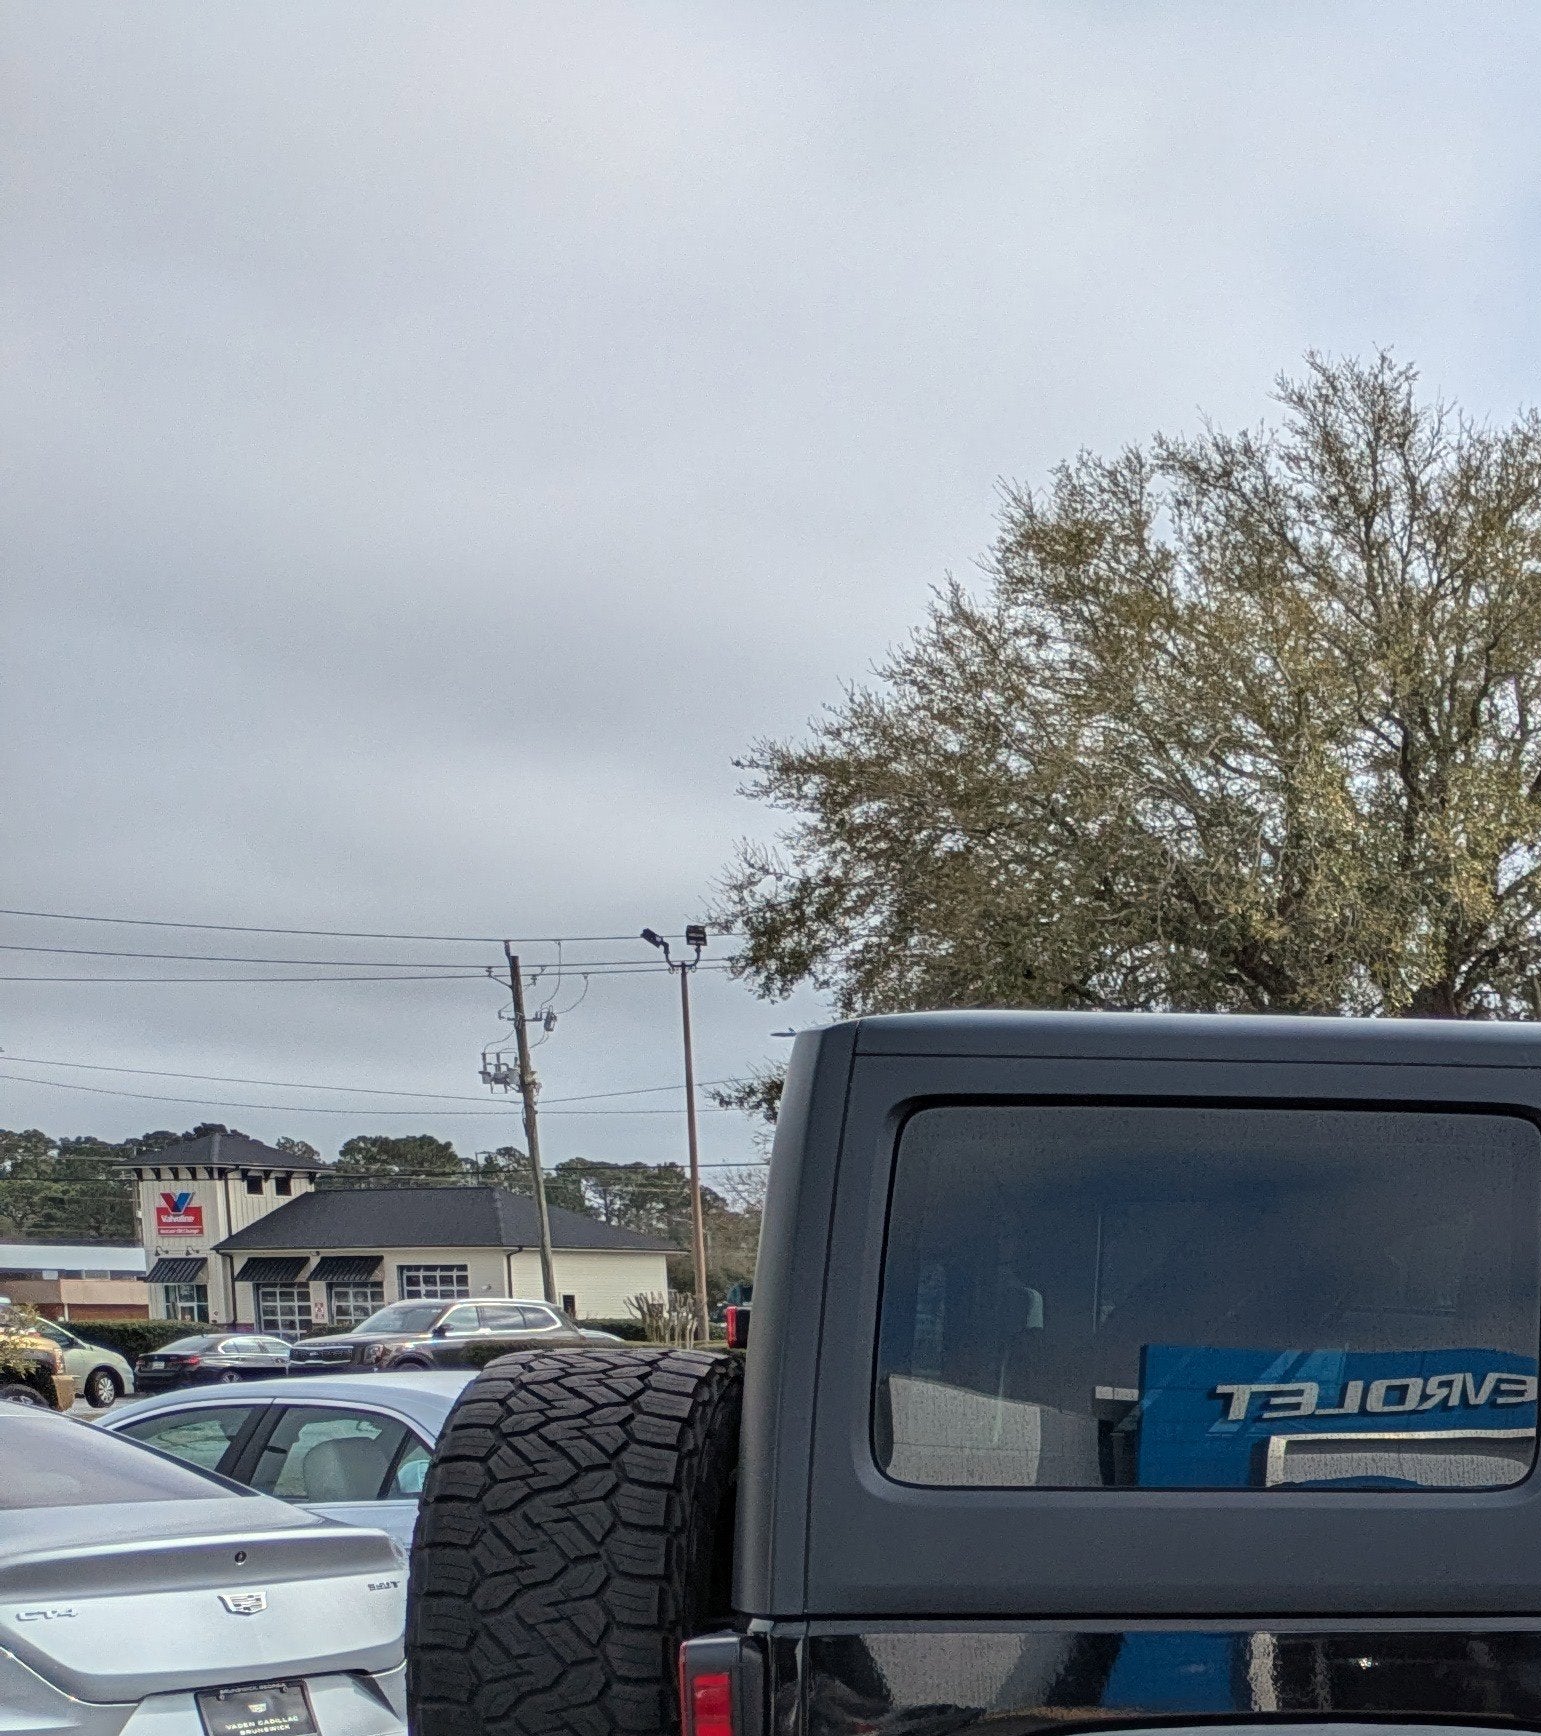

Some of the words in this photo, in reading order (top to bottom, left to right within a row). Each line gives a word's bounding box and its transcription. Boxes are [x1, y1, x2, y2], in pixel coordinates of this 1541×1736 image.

[15, 1608, 78, 1622] CT4
[225, 1720, 256, 1731] VADEN
[257, 1715, 300, 1727] CADILLAC
[239, 1724, 290, 1736] BRUNSWICK
